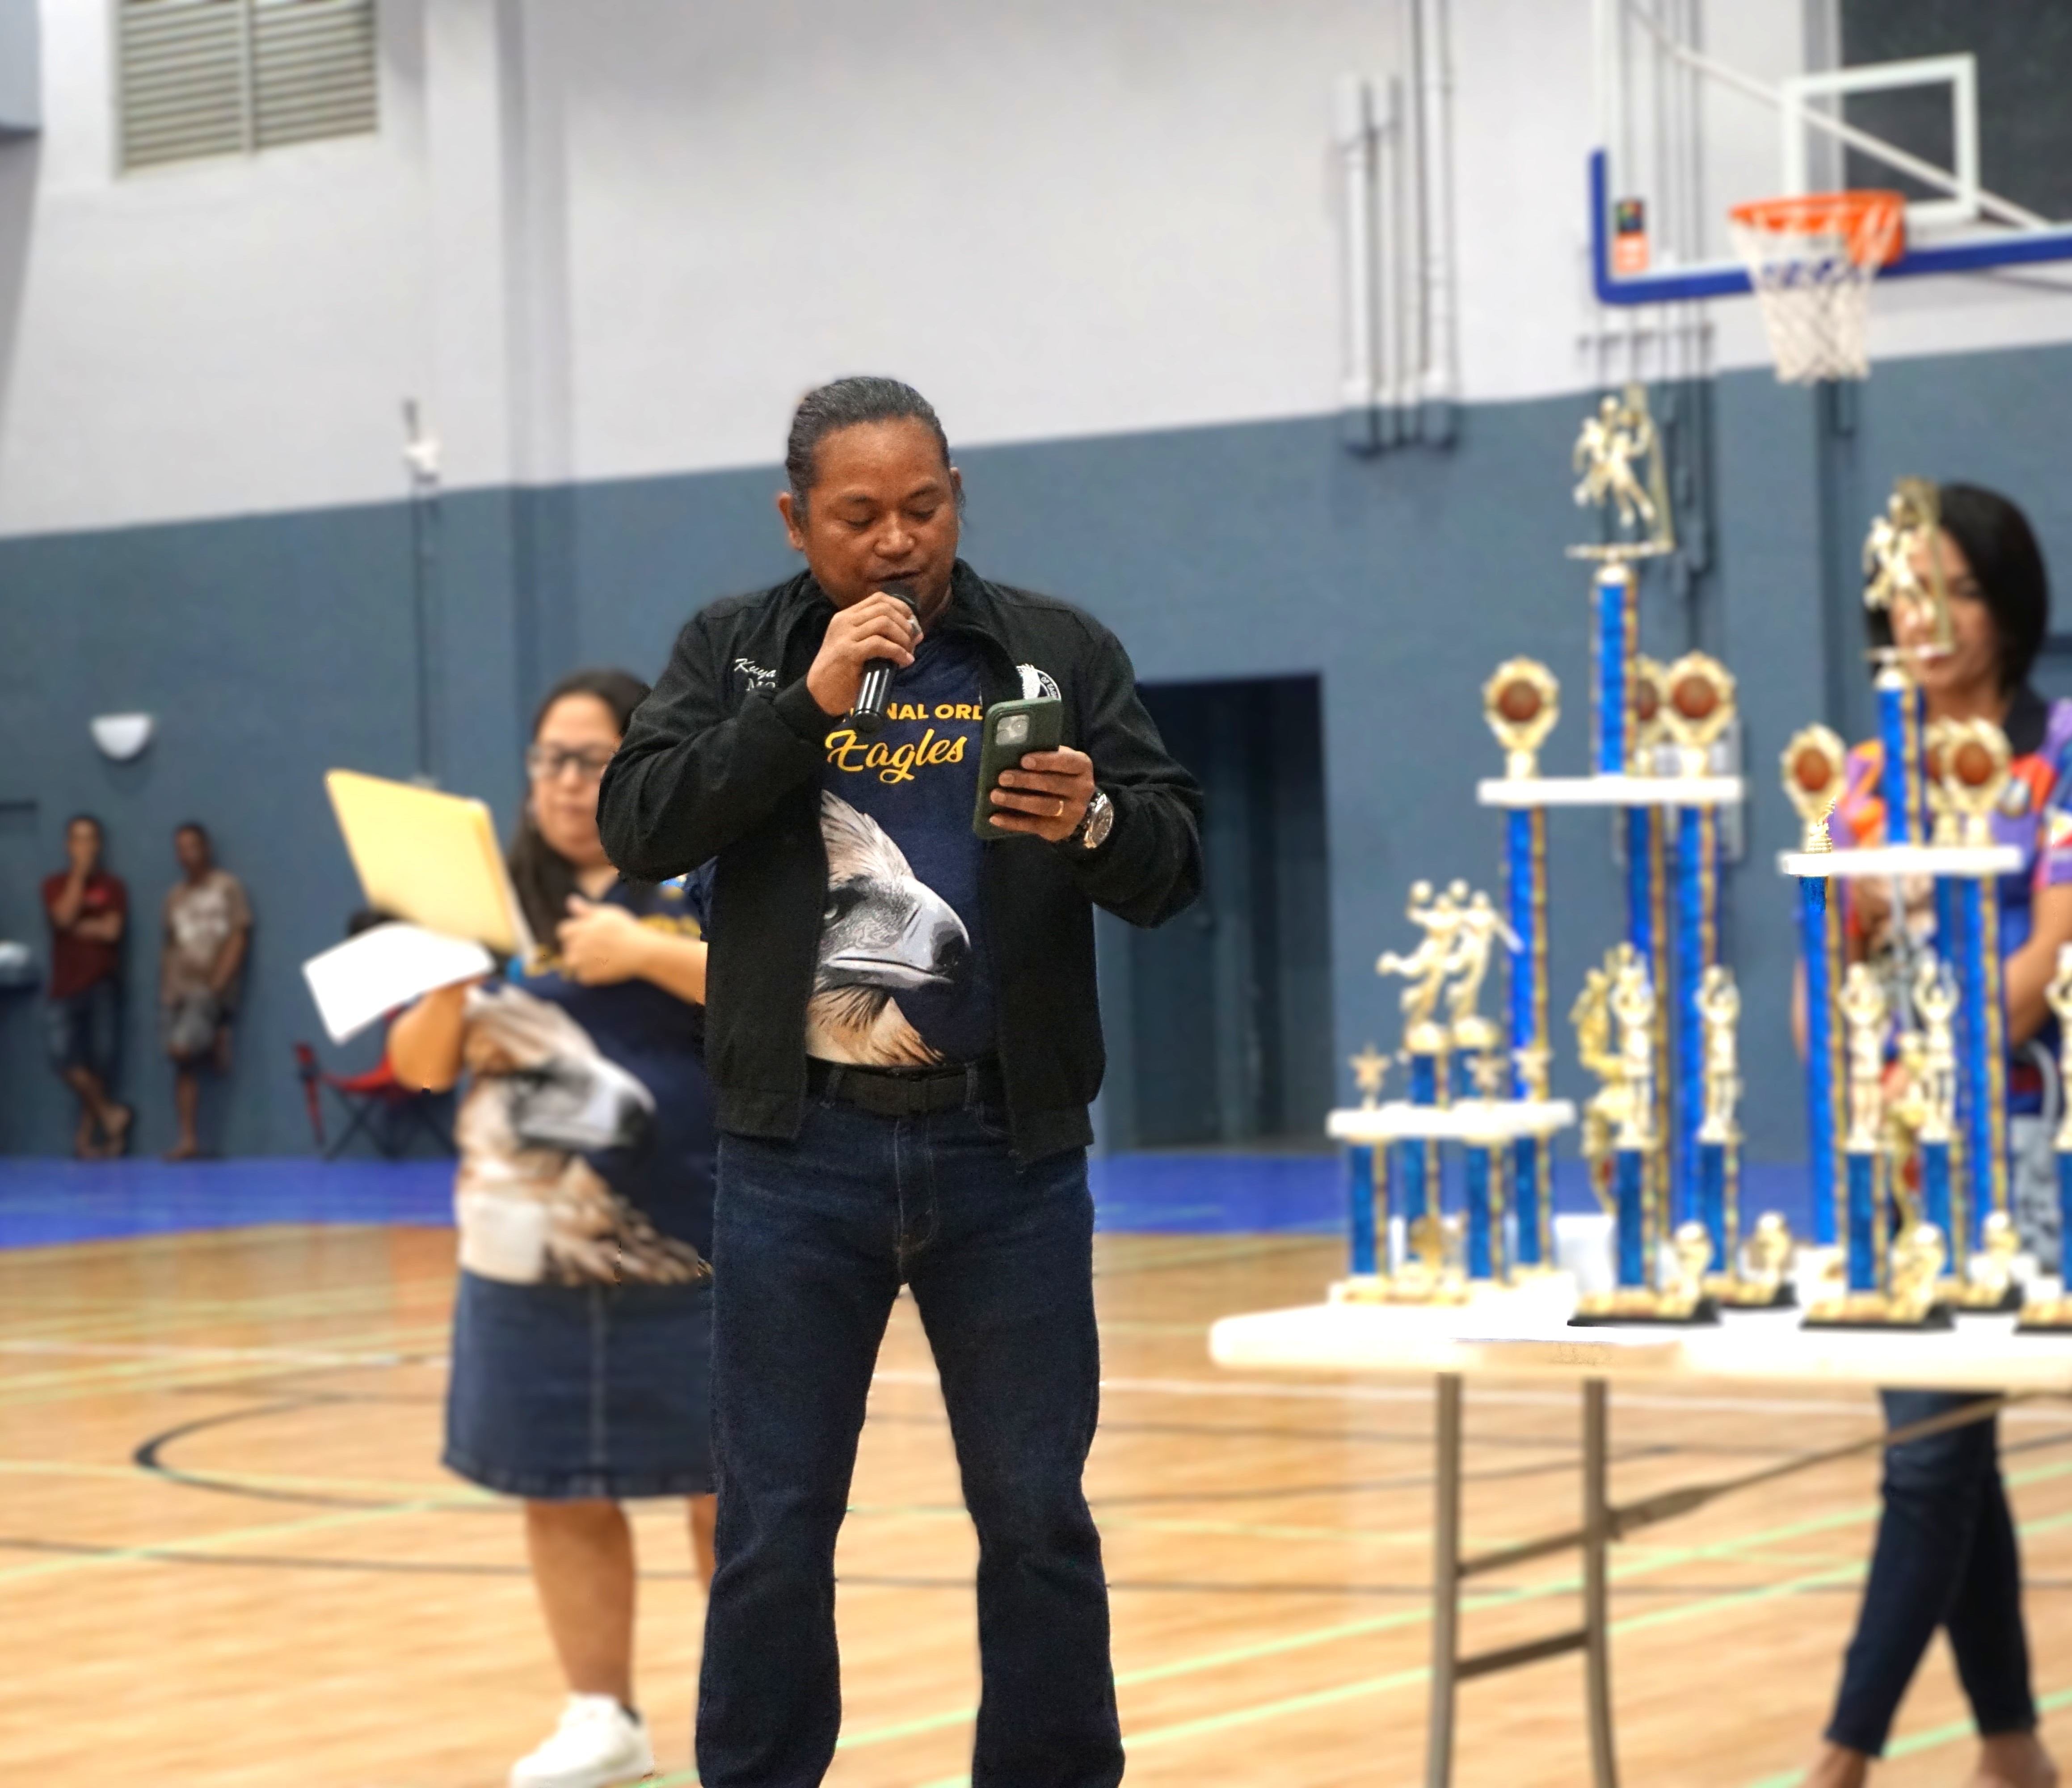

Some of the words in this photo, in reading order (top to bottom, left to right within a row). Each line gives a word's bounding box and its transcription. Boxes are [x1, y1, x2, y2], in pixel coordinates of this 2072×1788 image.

[734, 658, 776, 680] Kuya
[1047, 683, 1057, 698] EAG
[825, 728, 968, 783] Eagles
